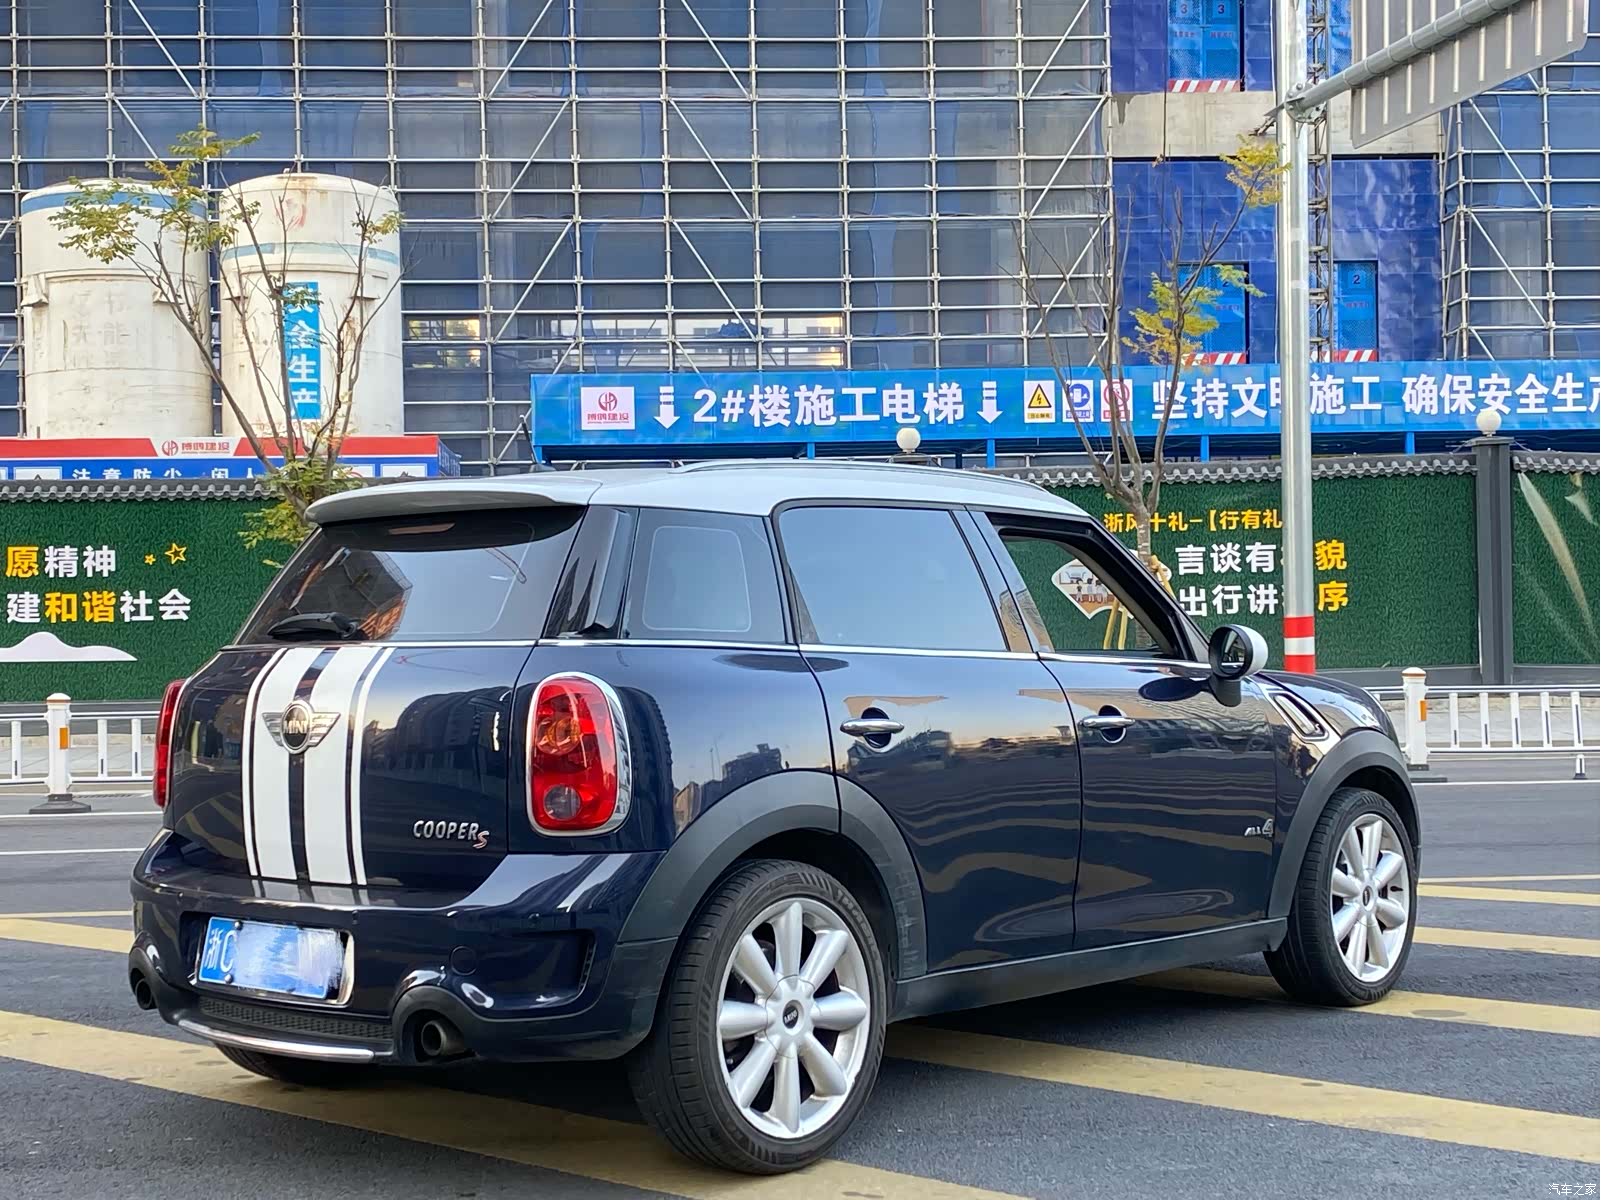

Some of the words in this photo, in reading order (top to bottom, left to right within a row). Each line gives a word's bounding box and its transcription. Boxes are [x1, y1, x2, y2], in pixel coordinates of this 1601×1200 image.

[1217, 4, 1225, 14] 3
[1353, 275, 1361, 285] 2
[693, 382, 965, 428] 2#楼施工电梯
[1152, 372, 1383, 420] 坚持文施工
[5, 545, 117, 578] 愿精神
[1175, 539, 1347, 576] 言谈有貌
[6, 588, 192, 624] 建和谐社会
[1179, 580, 1349, 617] 出行讲序
[283, 719, 308, 734] MINI
[413, 820, 479, 841] COOPER
